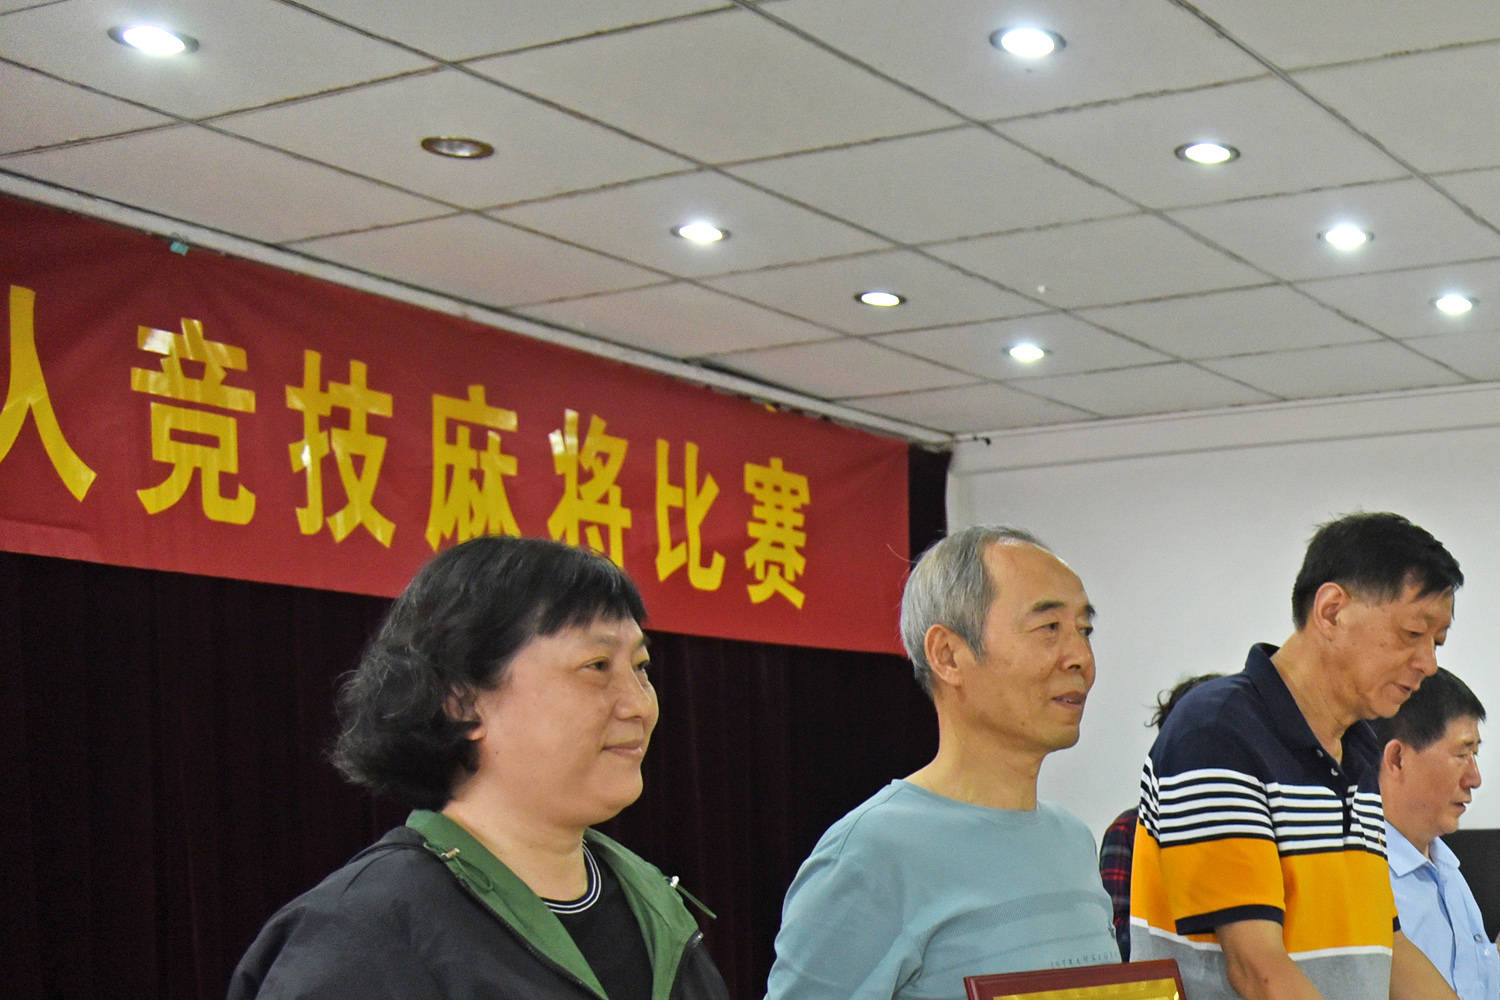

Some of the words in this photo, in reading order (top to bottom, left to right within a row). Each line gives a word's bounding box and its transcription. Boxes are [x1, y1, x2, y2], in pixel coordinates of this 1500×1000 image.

[0, 285, 811, 609] 人竞技麻将比赛
